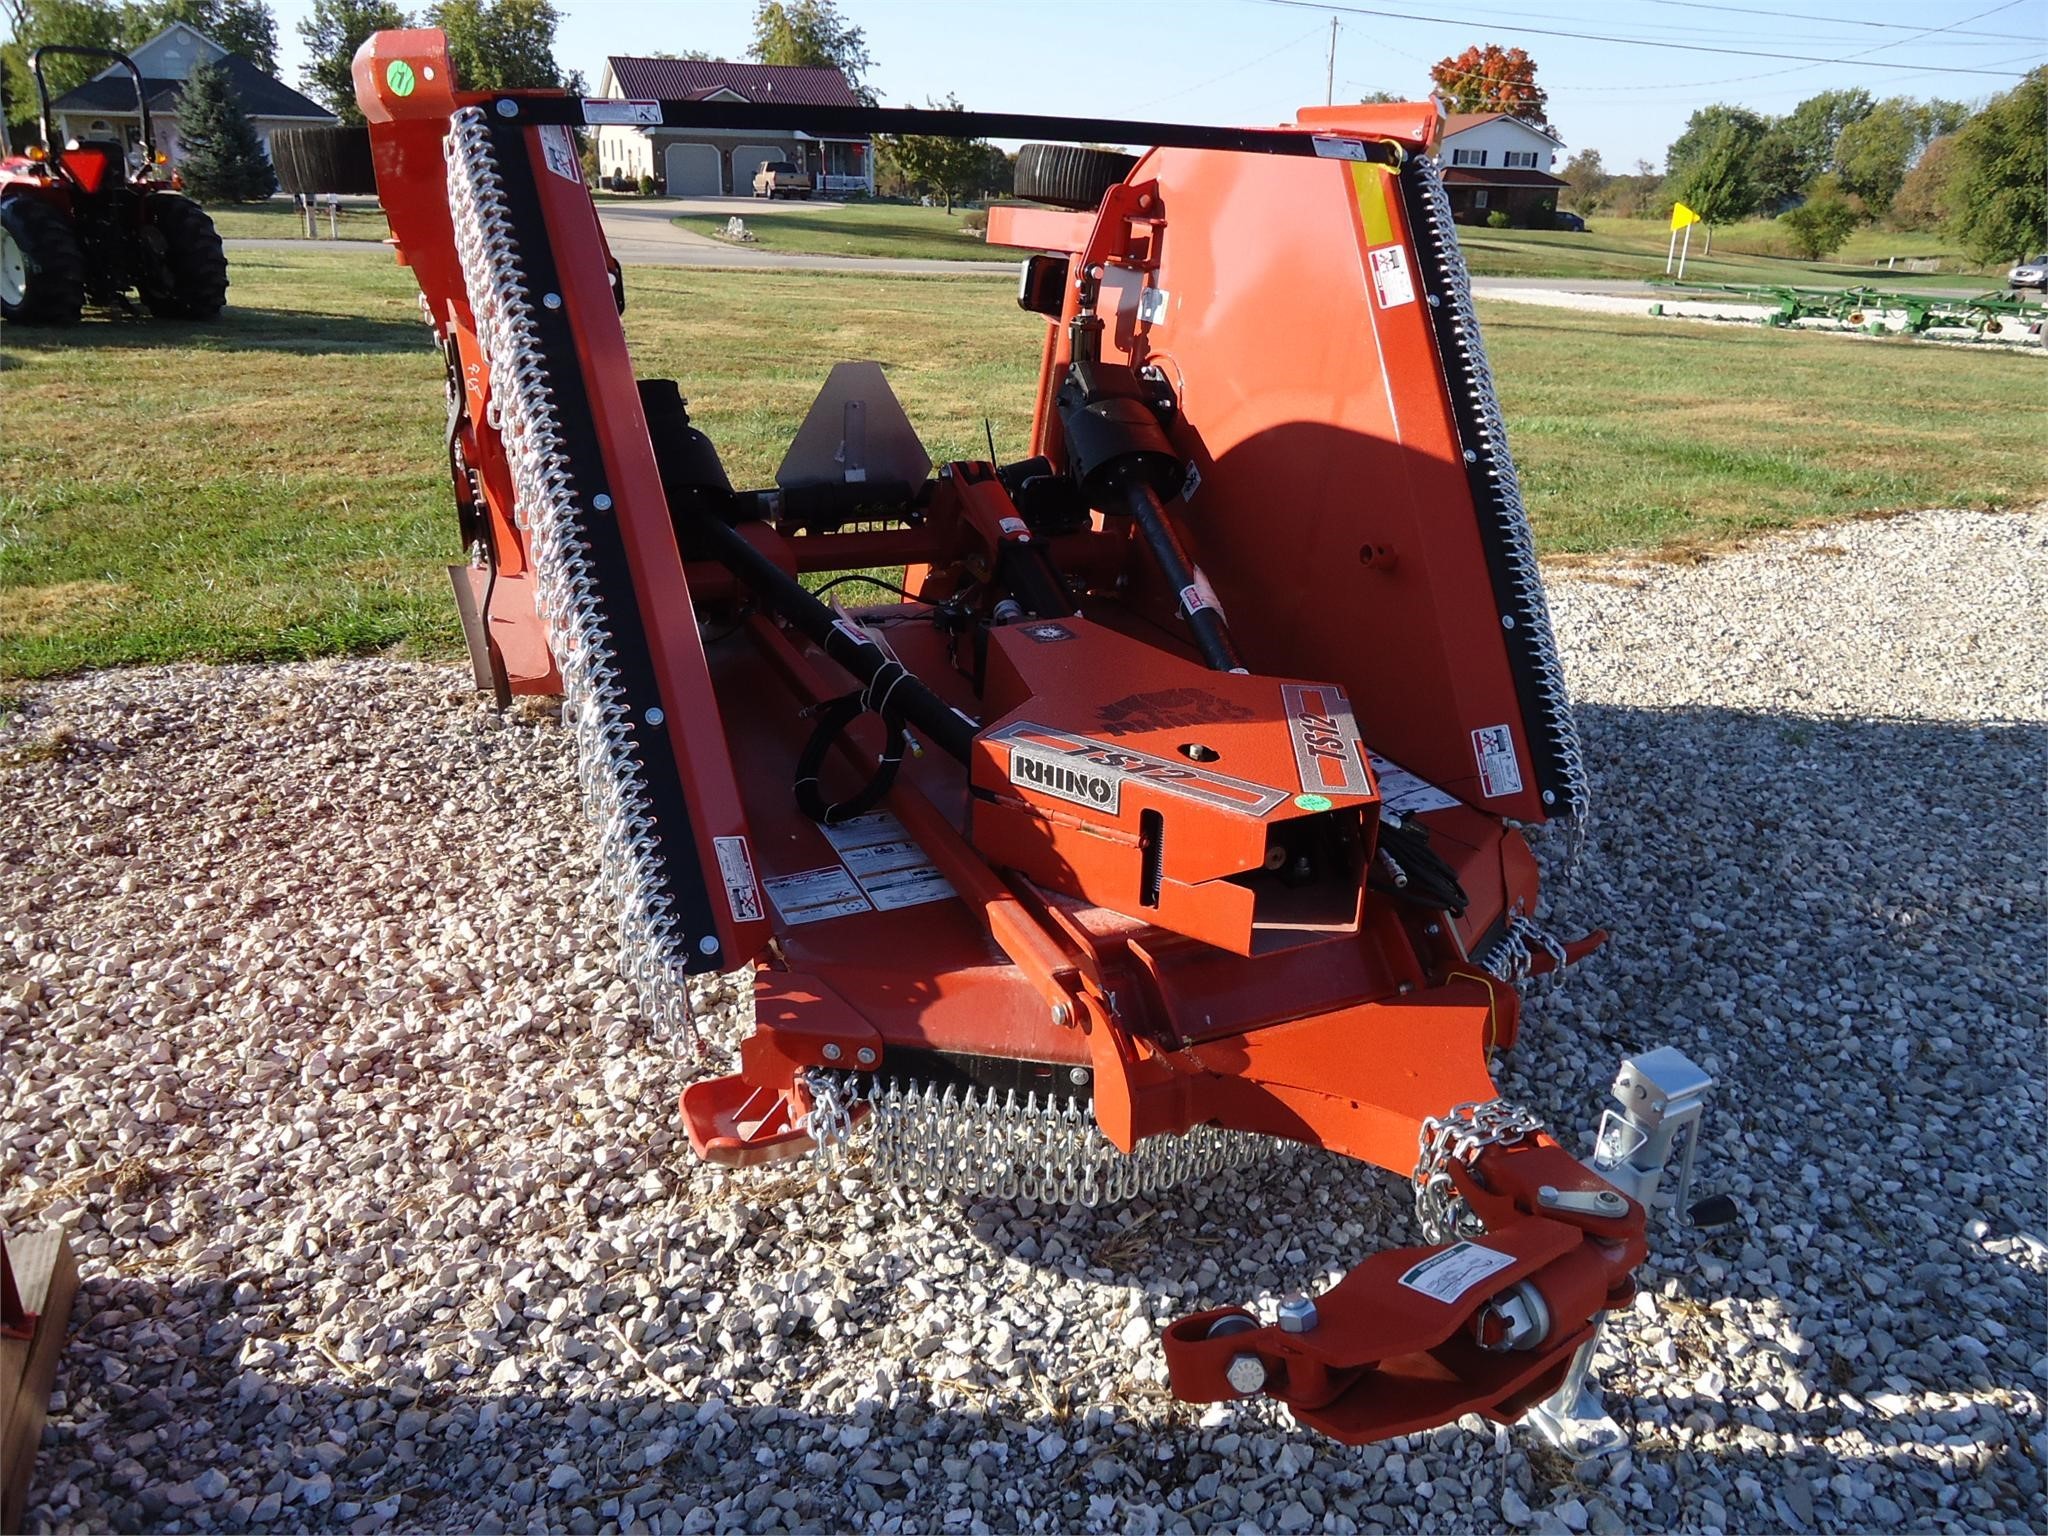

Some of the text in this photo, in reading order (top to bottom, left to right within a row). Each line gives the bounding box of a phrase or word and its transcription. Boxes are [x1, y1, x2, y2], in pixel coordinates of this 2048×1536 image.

[1297, 711, 1348, 762] TS12
[1016, 755, 1112, 804] RHINO
[1063, 744, 1198, 783] TS12
